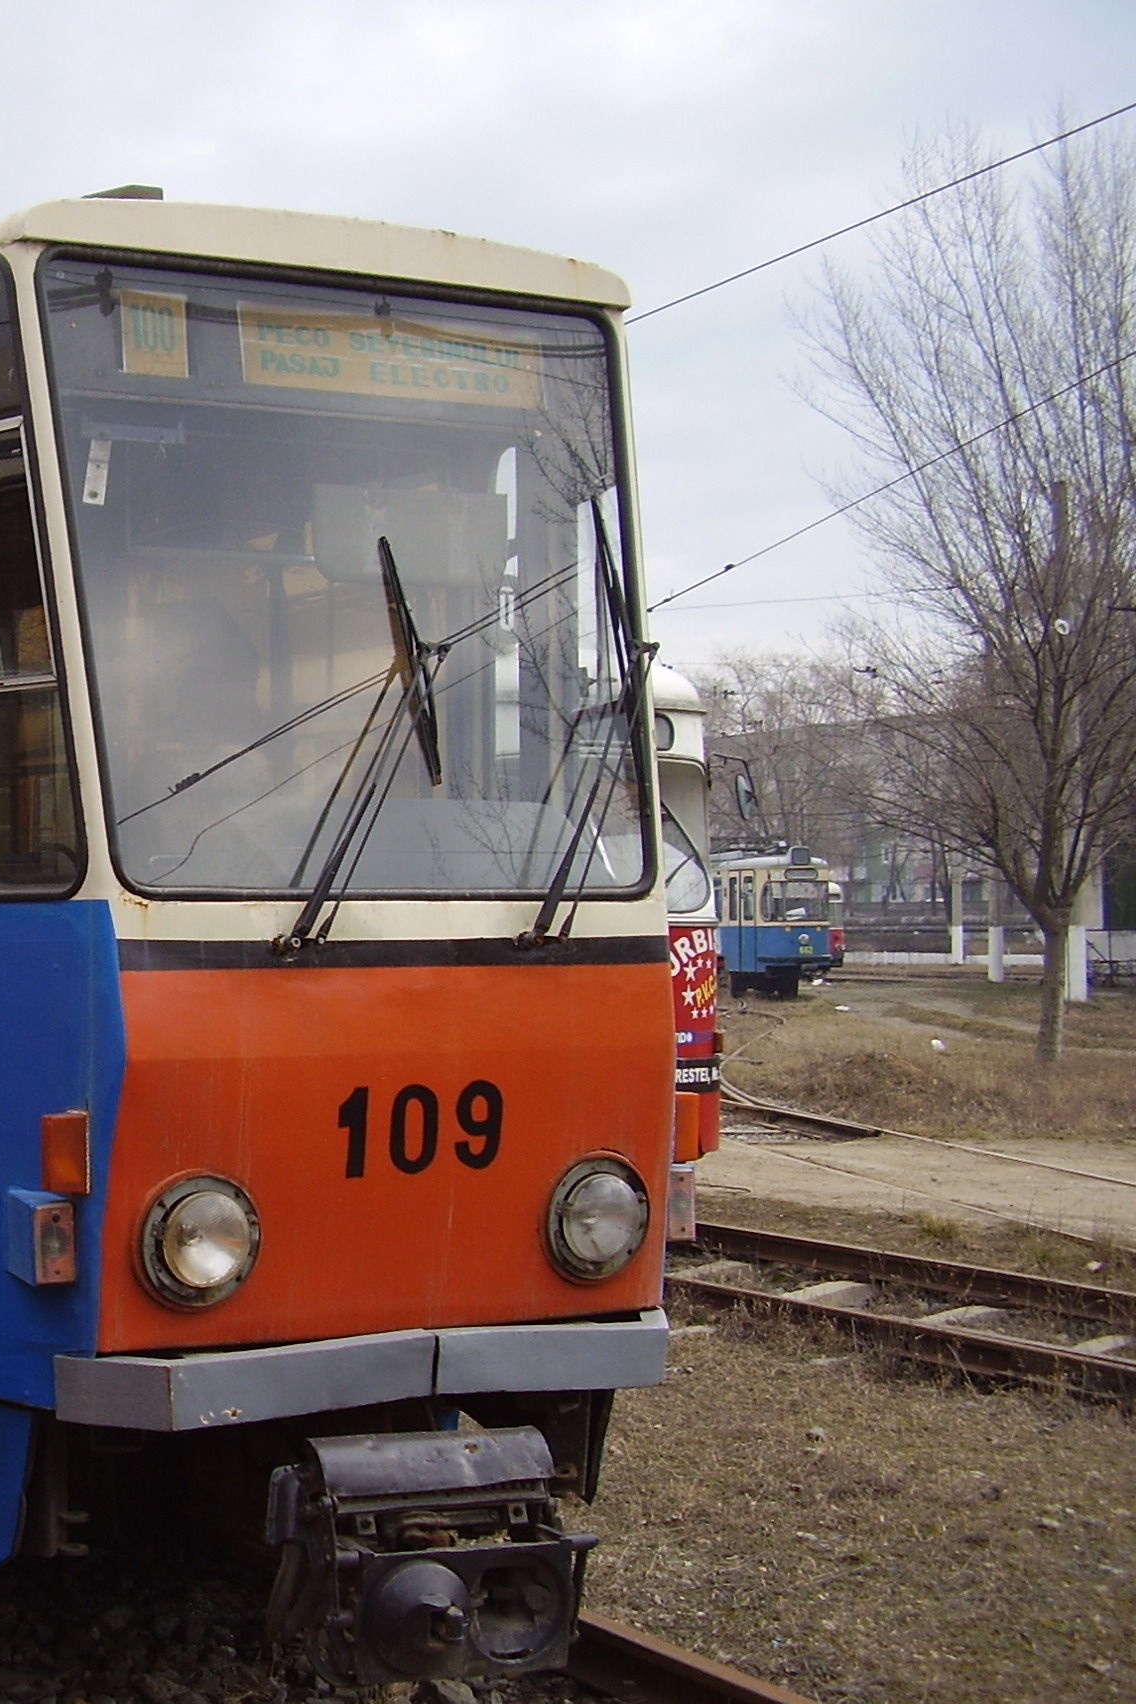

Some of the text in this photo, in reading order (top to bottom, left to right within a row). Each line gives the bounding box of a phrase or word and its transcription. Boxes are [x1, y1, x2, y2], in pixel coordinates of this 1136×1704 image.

[257, 321, 331, 347] PECO
[260, 350, 510, 394] PASAJ ELECTRO
[338, 1079, 504, 1179] 109
